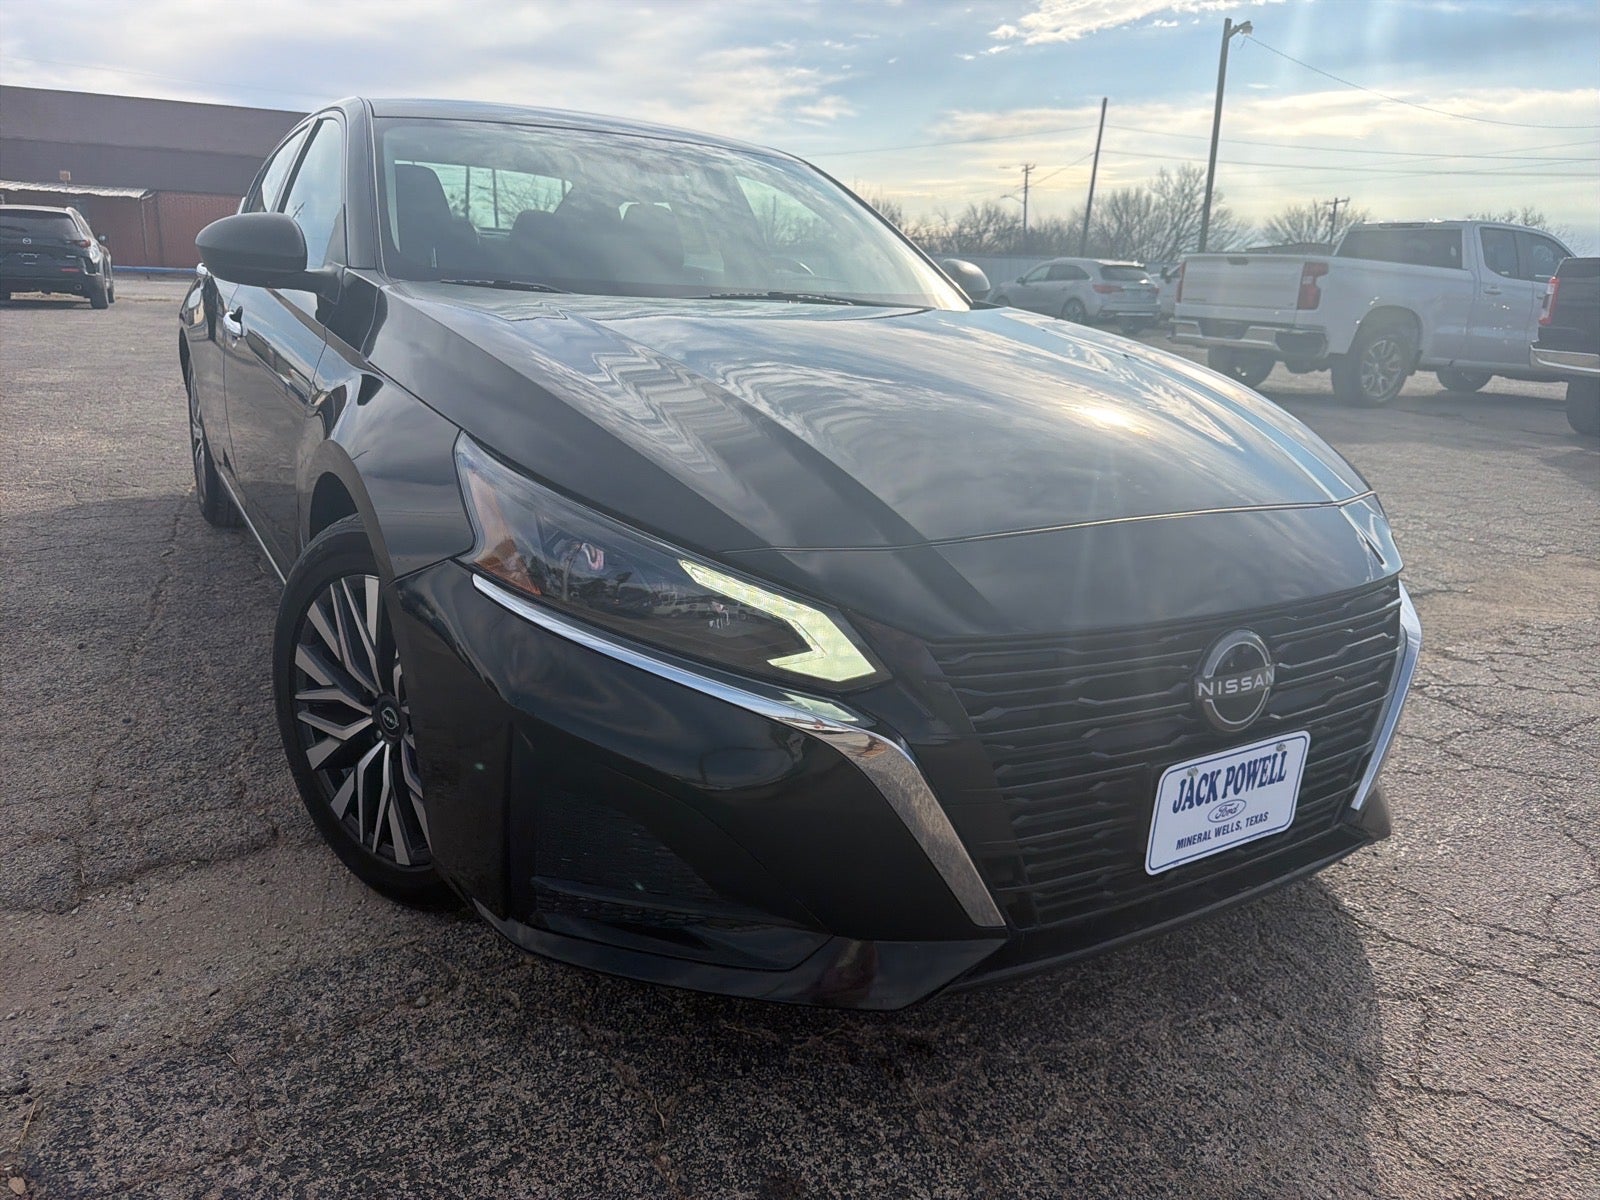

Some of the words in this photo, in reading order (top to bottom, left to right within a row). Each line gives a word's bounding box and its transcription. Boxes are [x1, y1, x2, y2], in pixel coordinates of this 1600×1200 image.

[1198, 665, 1275, 696] NISSAN
[1172, 769, 1222, 814] JACK
[1222, 751, 1288, 799] POWELL
[1214, 802, 1240, 820] Ford
[1176, 830, 1212, 850] MINERAL
[1245, 811, 1269, 828] TEXAS
